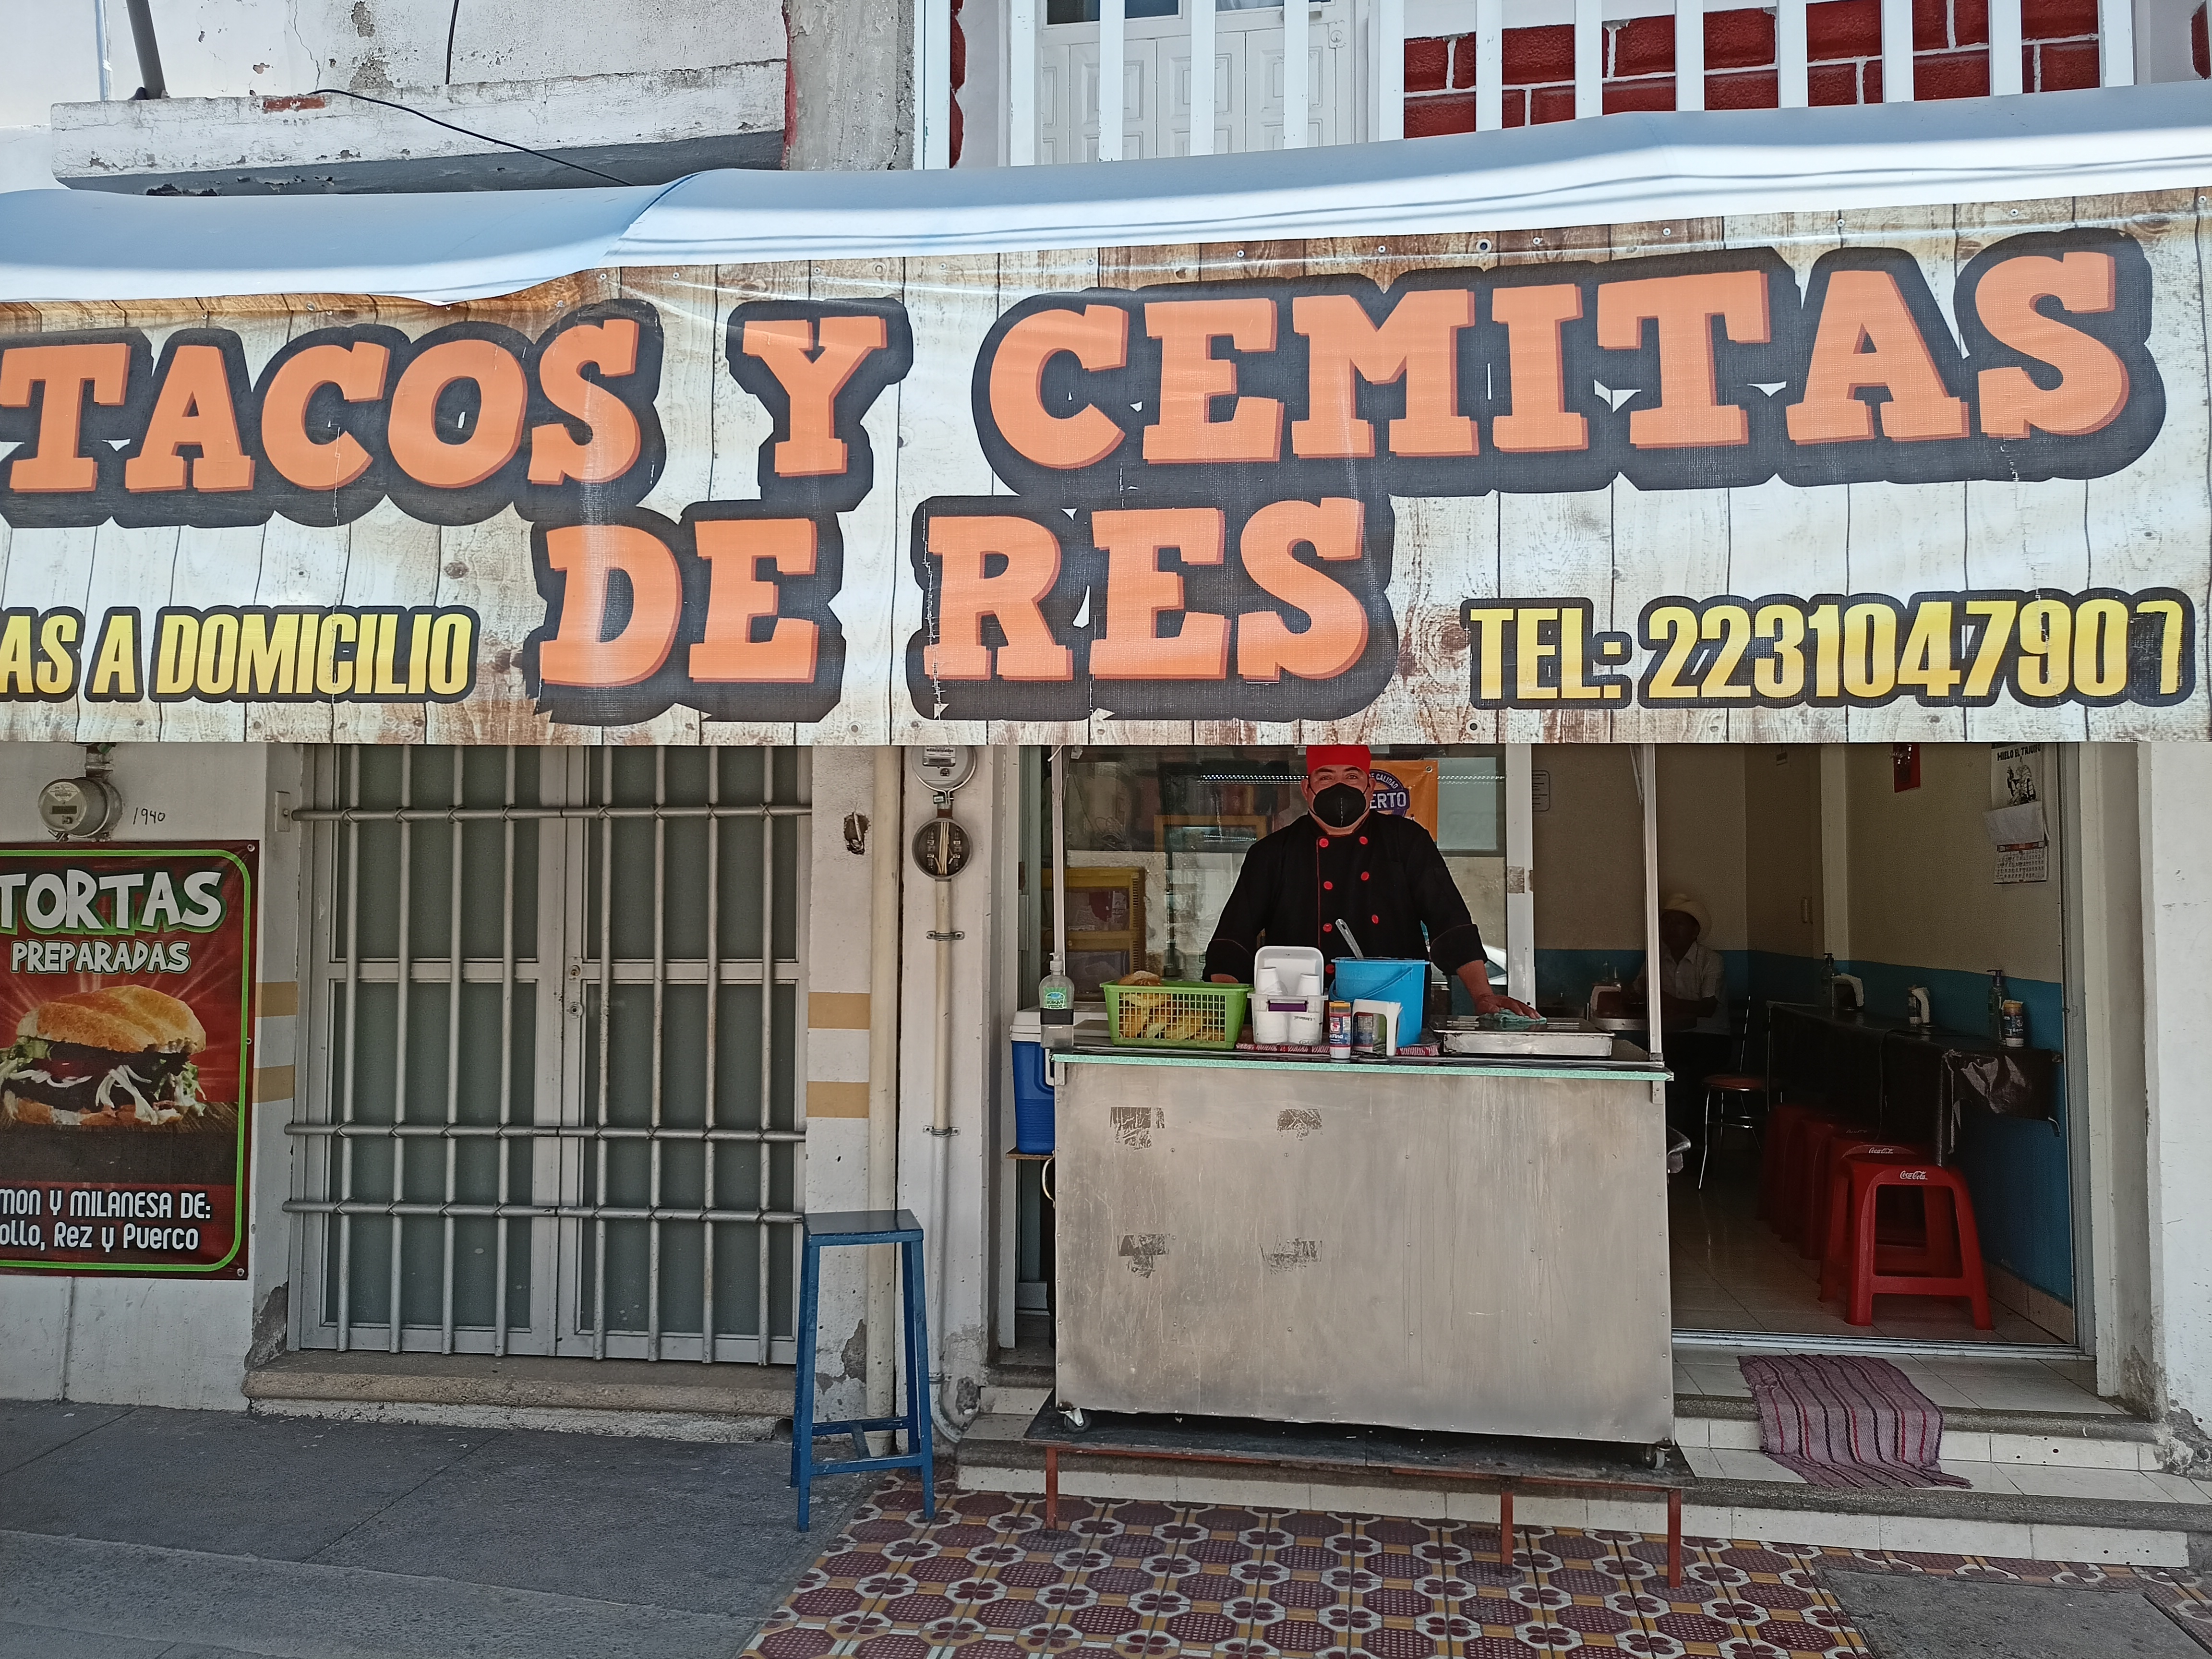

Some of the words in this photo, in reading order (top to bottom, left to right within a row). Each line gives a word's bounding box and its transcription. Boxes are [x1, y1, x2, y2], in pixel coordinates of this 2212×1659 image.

[0, 319, 641, 493] TACOS
[743, 316, 887, 477] Y
[989, 252, 2129, 469] CEMITAS
[540, 518, 819, 686] DE
[924, 497, 1370, 682] RES
[0, 615, 78, 694] AS
[92, 615, 136, 694] A
[156, 613, 472, 695] DOMICILIO
[1470, 607, 1622, 699] TEL:
[1647, 599, 2184, 698] 2231047907
[1997, 749, 2014, 761] HIELO
[2015, 748, 2020, 758] EL
[1376, 773, 1399, 790] CALIDAD
[132, 807, 166, 825] 1940
[1369, 792, 1407, 809] ERTO
[0, 869, 222, 929] TORTAS
[11, 939, 191, 974] PREPARADAS
[49, 1190, 62, 1216] Y
[70, 1190, 172, 1218] MILANESA
[180, 1192, 211, 1219] DE:
[53, 1221, 93, 1248] Rez
[101, 1226, 114, 1253] y
[123, 1223, 199, 1250] Puerco
